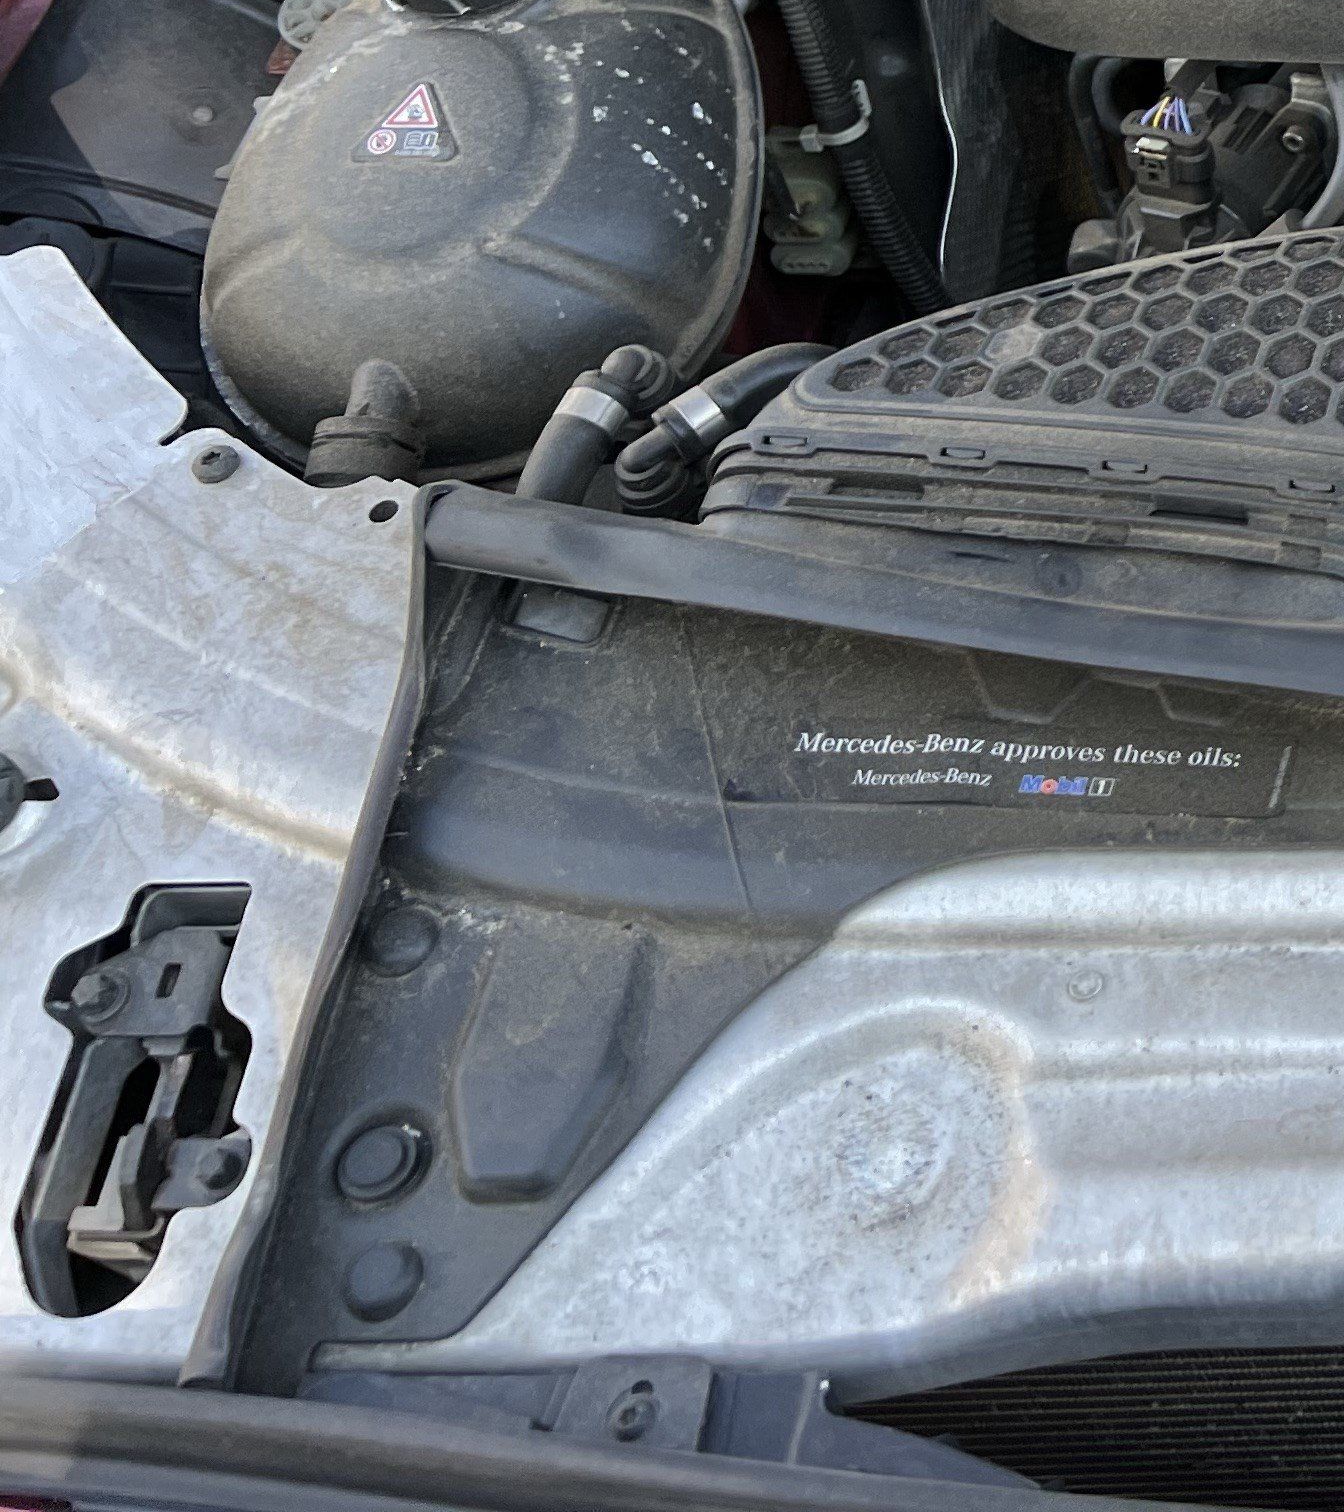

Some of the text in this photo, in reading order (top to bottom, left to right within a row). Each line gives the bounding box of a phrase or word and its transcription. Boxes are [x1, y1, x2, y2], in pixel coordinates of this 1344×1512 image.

[793, 732, 1242, 768] Mercedes-Benz approves these oils:
[851, 767, 993, 787] Mercedes-Benz
[1018, 774, 1088, 796] Mobil
